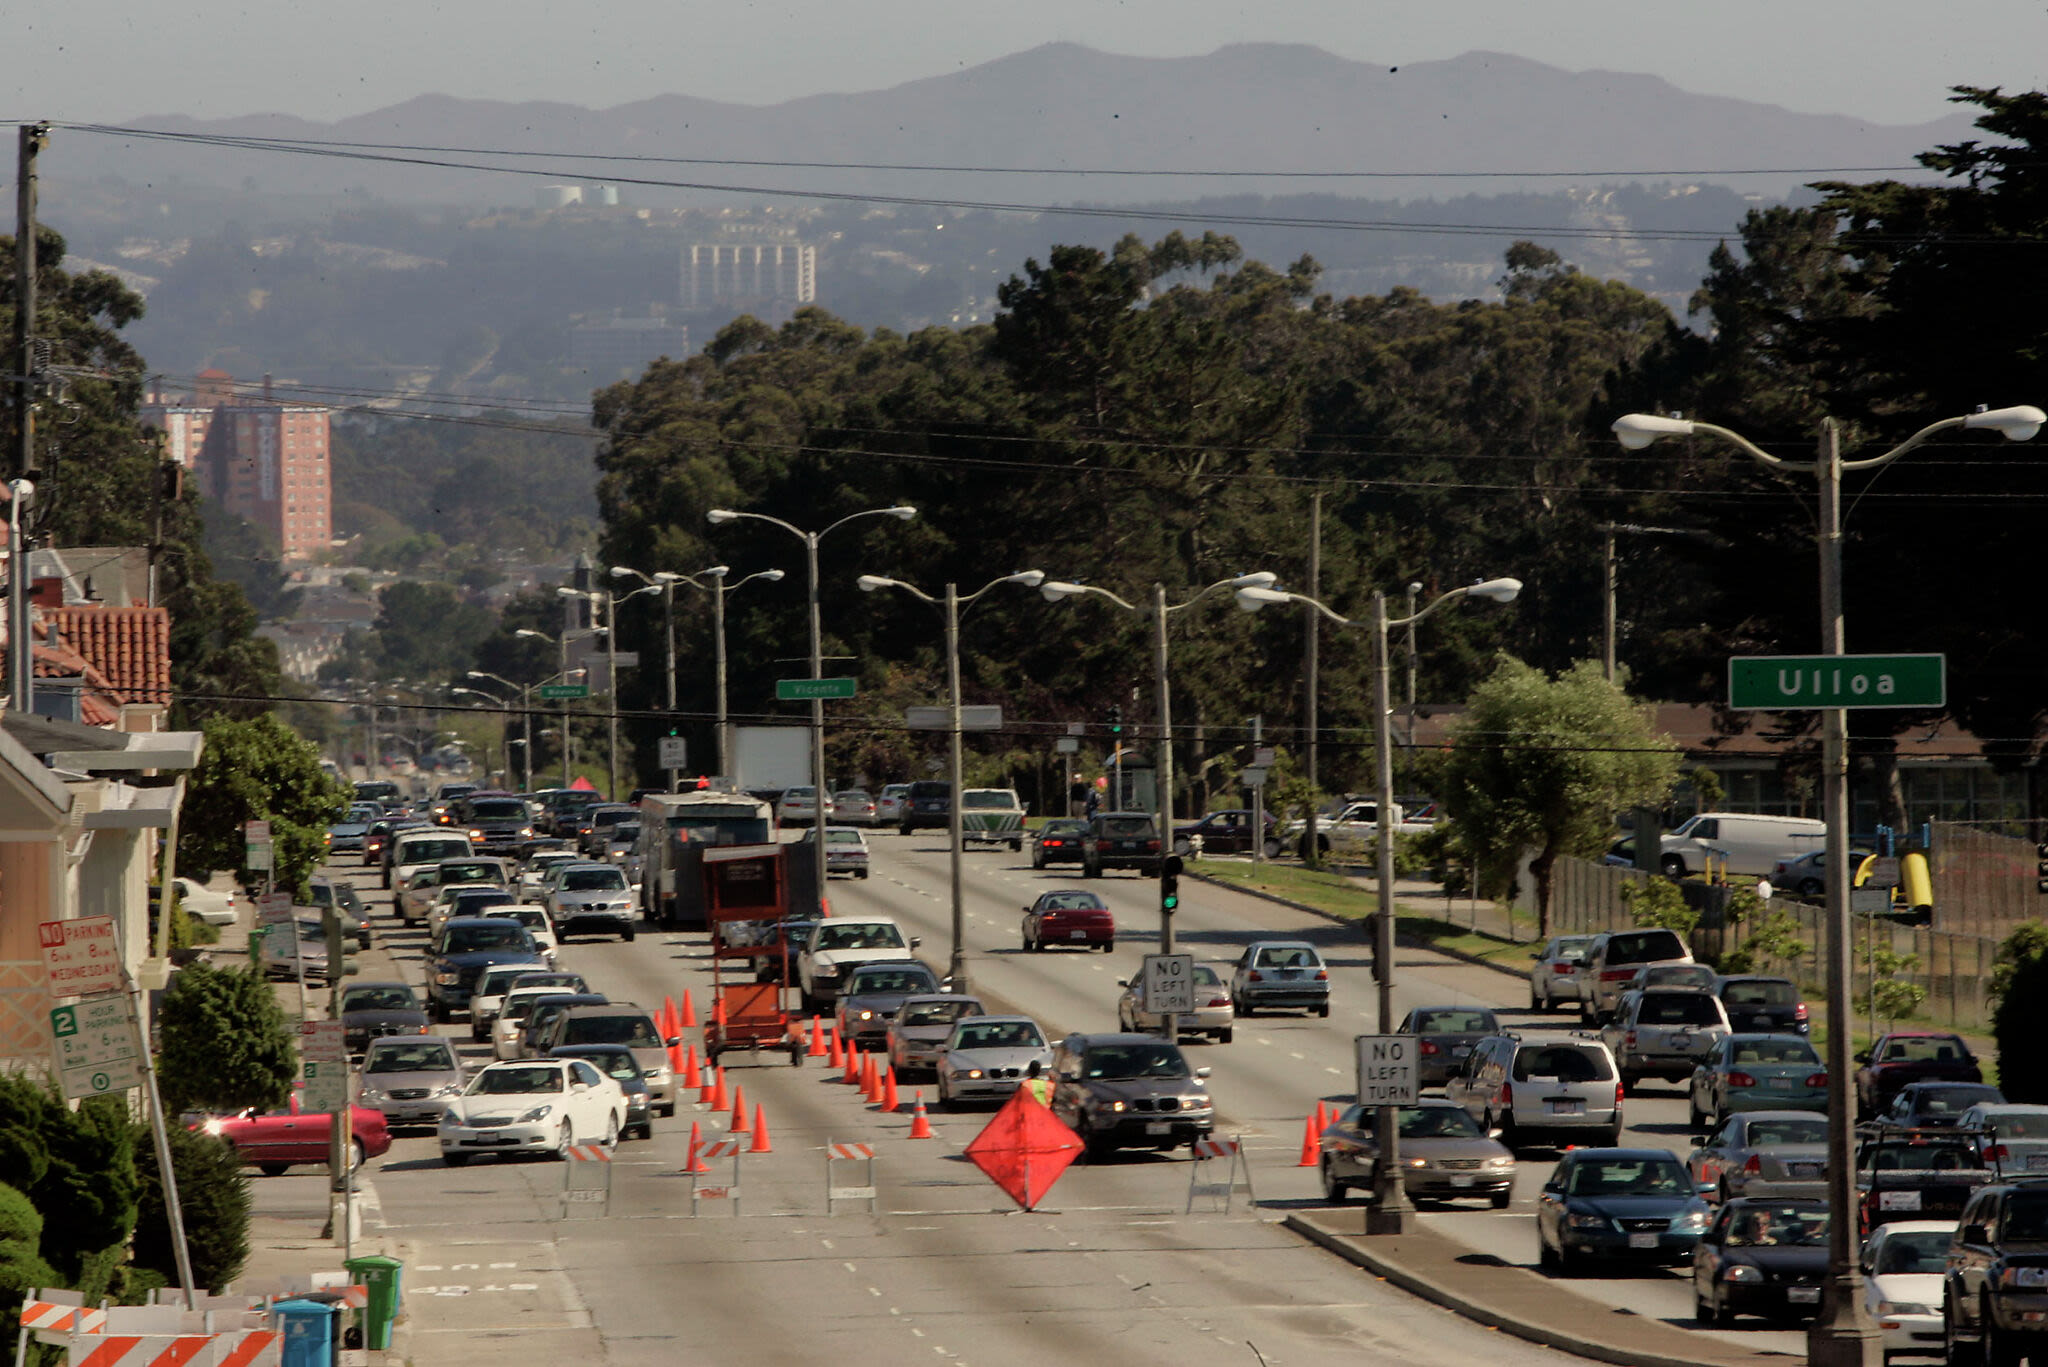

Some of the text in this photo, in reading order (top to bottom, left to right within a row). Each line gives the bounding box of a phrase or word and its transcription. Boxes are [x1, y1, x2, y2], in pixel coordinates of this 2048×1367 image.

[793, 684, 841, 695] Vicente
[1778, 669, 1896, 696] Ulloa
[41, 923, 113, 945] NO PARKING
[50, 964, 117, 981] WEDNESDAY
[1156, 961, 1181, 976] NO
[1152, 980, 1186, 993] LEFT
[1153, 996, 1188, 1008] TURN
[54, 1013, 75, 1033] 2
[1373, 1042, 1404, 1061] NO
[1368, 1066, 1409, 1080] LEFT
[1369, 1086, 1410, 1100] TURN
